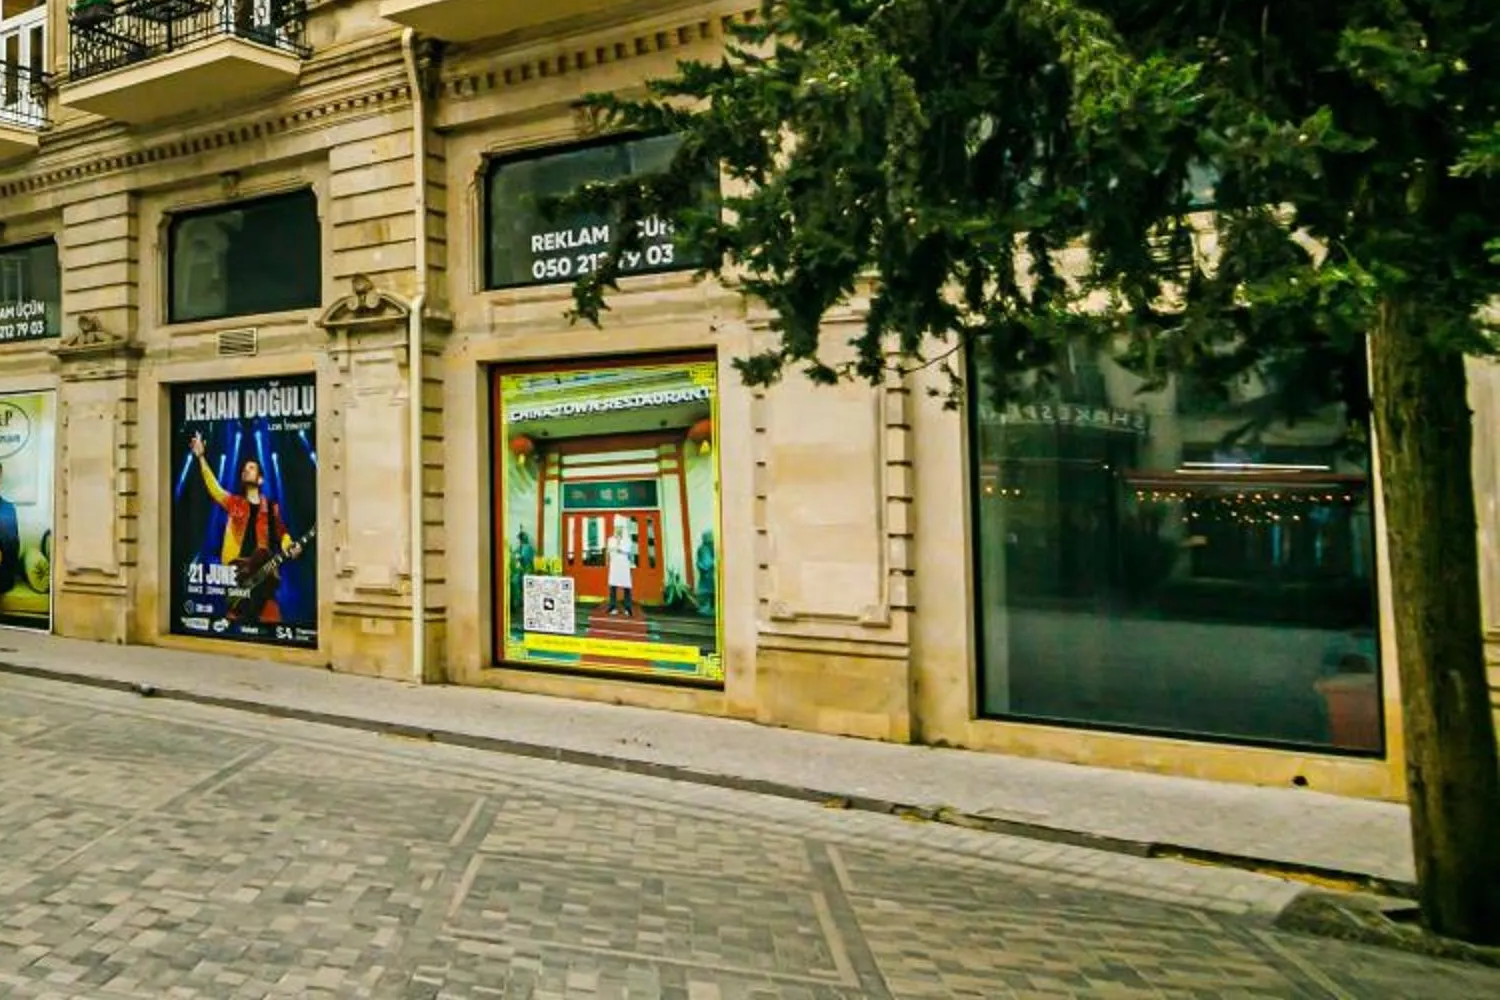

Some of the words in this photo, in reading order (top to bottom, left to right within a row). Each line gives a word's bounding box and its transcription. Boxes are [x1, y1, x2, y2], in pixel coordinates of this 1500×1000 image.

[531, 224, 610, 253] REKLAM
[531, 256, 572, 279] 050
[645, 243, 675, 265] 03
[15, 299, 45, 320] ÜÇÜN
[16, 321, 29, 337] 79
[30, 320, 45, 335] 03
[185, 390, 240, 421] KENAN
[243, 380, 315, 419] DOĞULU
[187, 563, 204, 584] 21
[205, 563, 238, 587] JUNE
